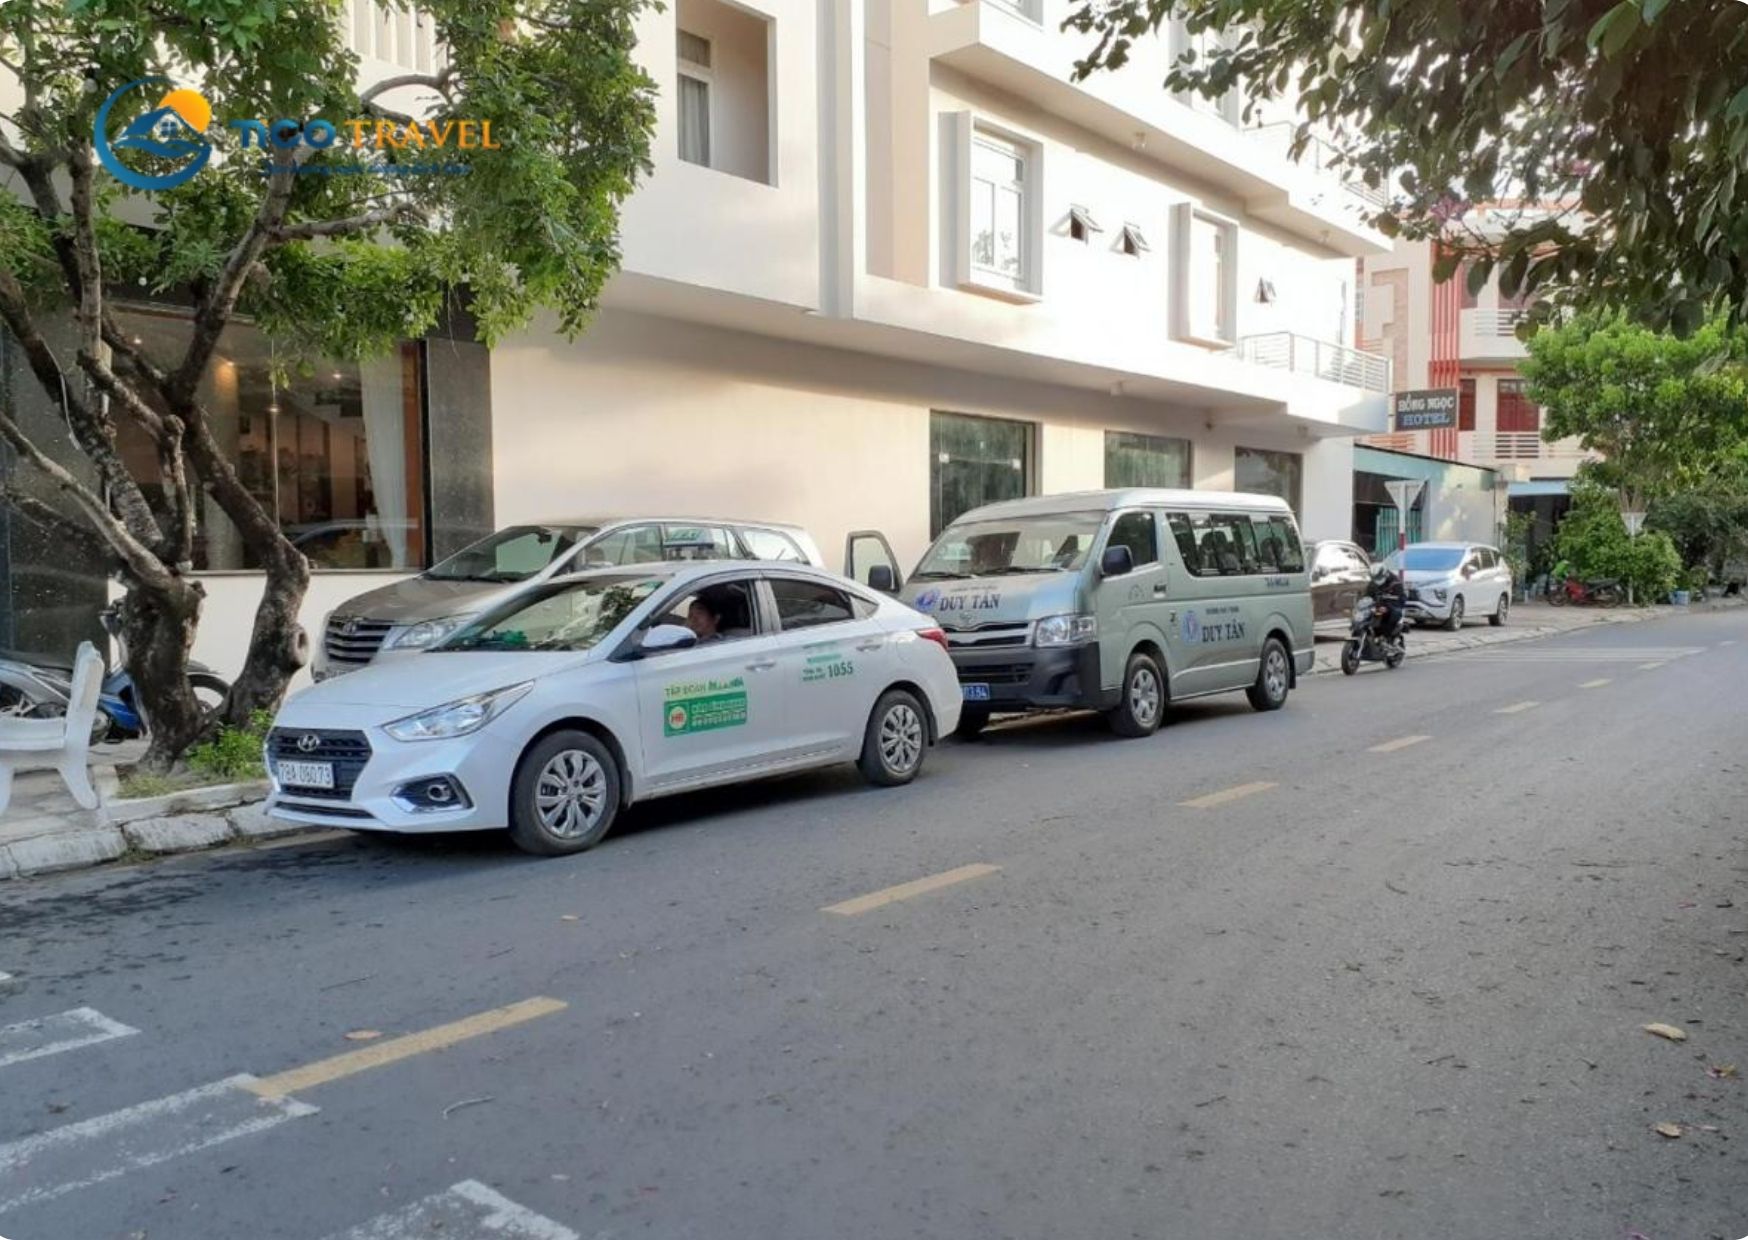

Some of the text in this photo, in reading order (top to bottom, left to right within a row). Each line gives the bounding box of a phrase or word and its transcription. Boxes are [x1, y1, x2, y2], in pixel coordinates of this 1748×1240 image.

[1403, 413, 1449, 425] HOTEL
[940, 595, 967, 611] DUY
[1202, 623, 1223, 643] DUY
[827, 661, 854, 678] 1055
